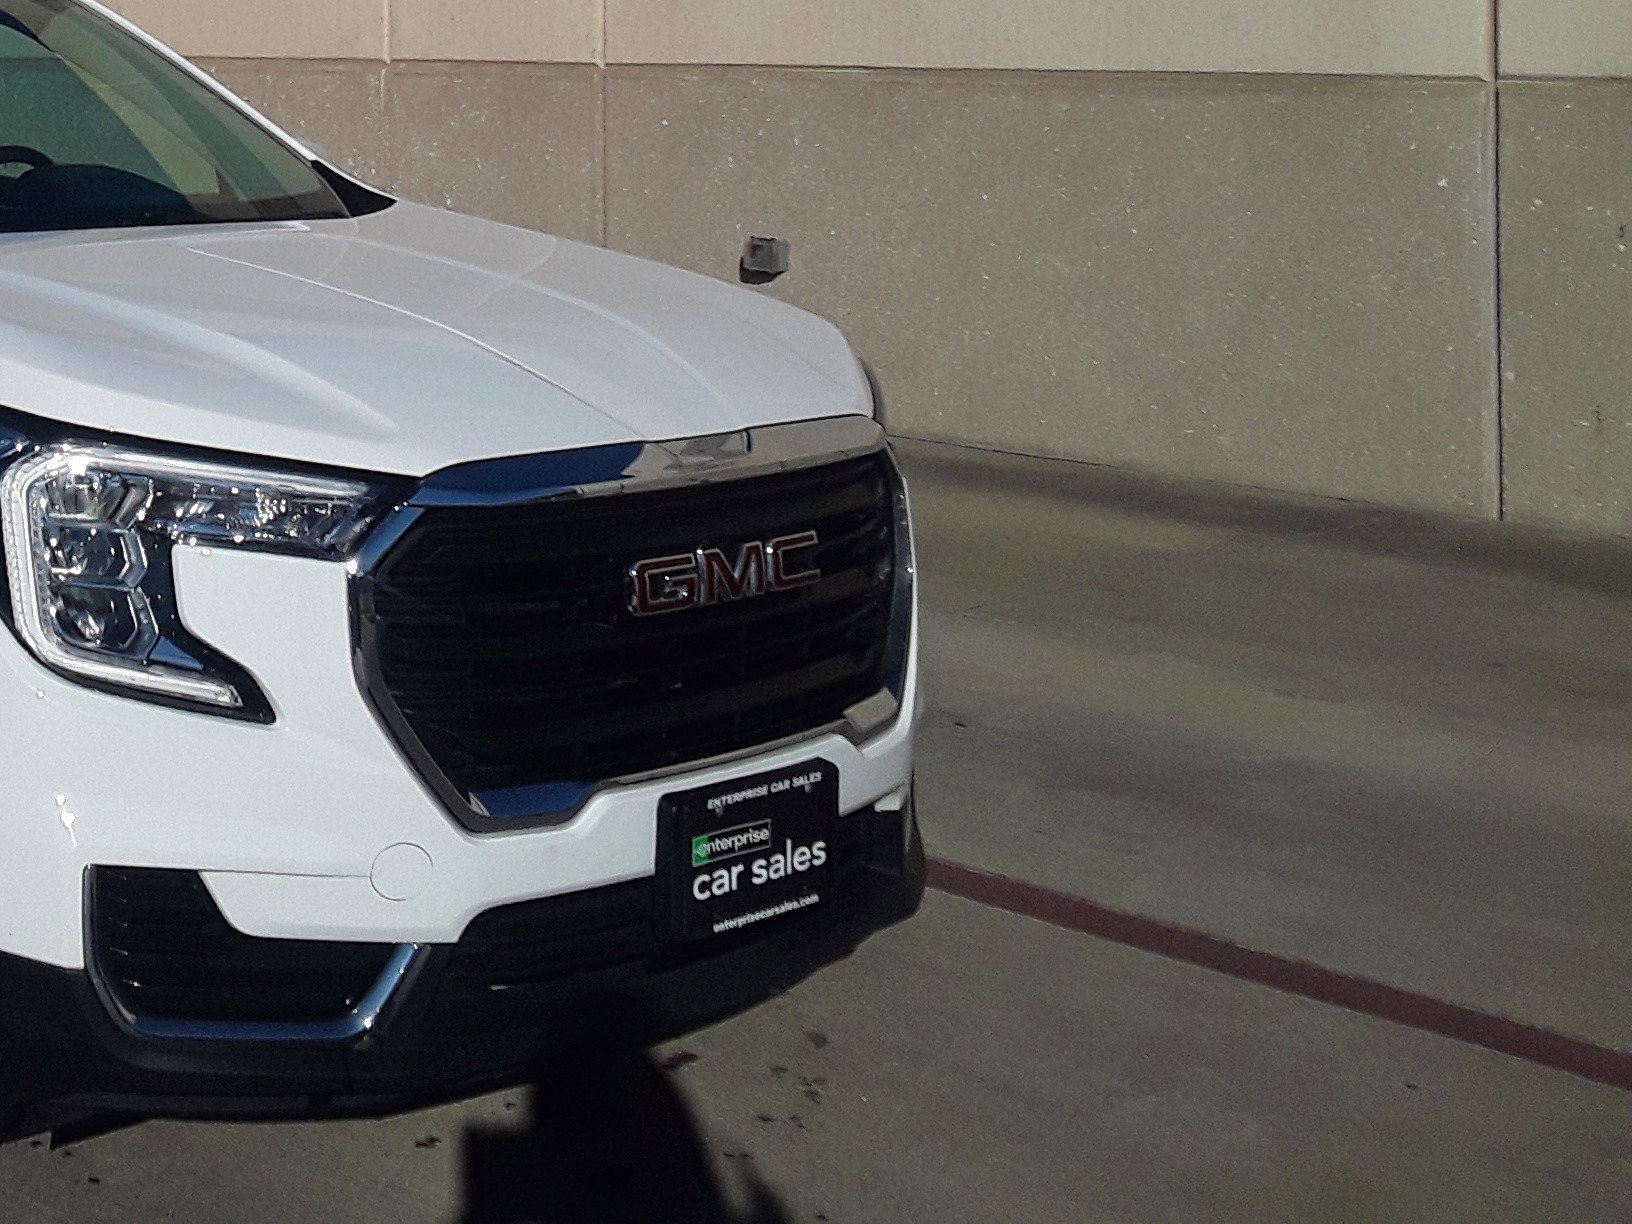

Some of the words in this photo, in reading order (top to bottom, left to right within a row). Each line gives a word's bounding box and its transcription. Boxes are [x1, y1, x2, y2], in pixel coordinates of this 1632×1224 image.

[628, 530, 820, 616] GMC
[707, 784, 769, 810] ENTERPRISE
[770, 778, 791, 794] CAR
[792, 771, 822, 788] SALES
[695, 827, 770, 859] enterprise
[692, 861, 745, 901] car
[751, 838, 827, 885] sales
[713, 893, 820, 933] enterprisecarsales.com
